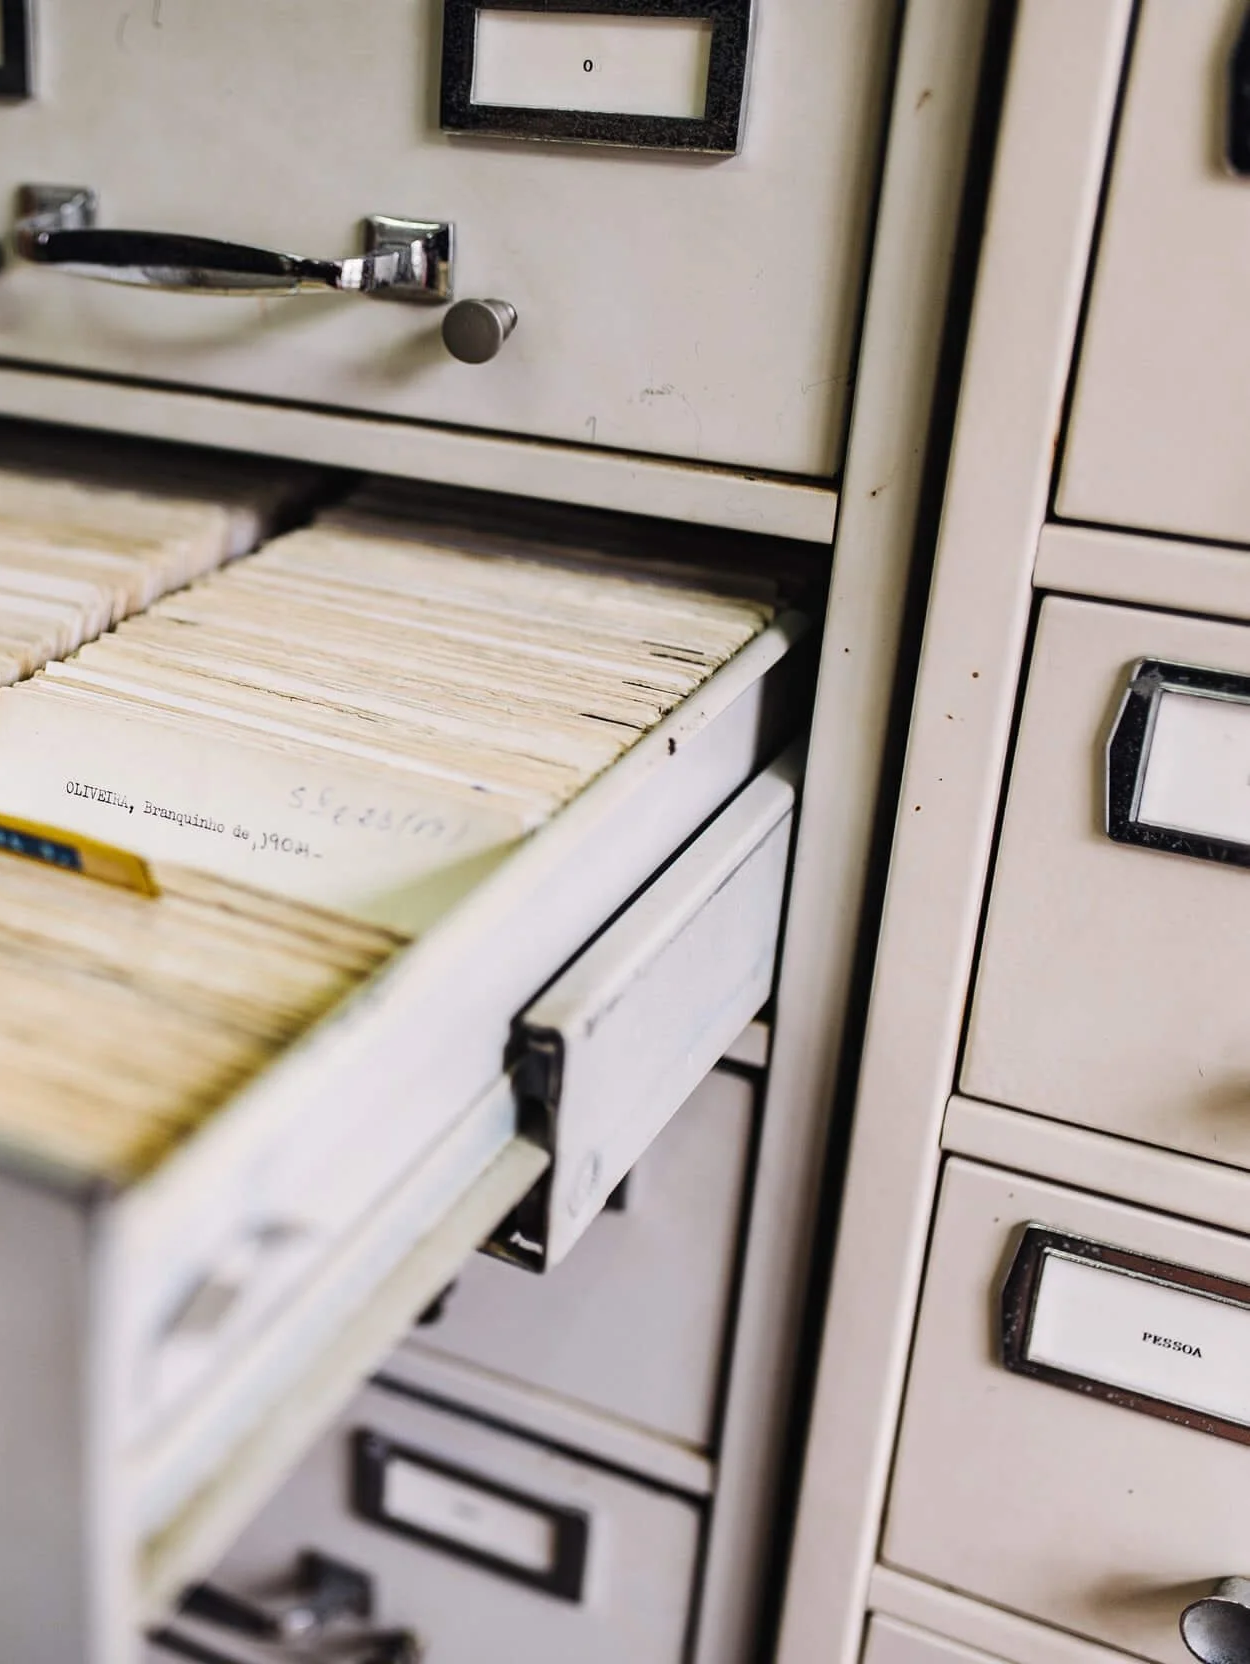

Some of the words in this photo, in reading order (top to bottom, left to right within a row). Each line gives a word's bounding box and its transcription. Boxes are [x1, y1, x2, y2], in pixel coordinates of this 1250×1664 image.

[66, 780, 135, 814] OLIVEIRA,
[143, 800, 225, 834] Branquinho
[1141, 1331, 1202, 1358] PESSOA
